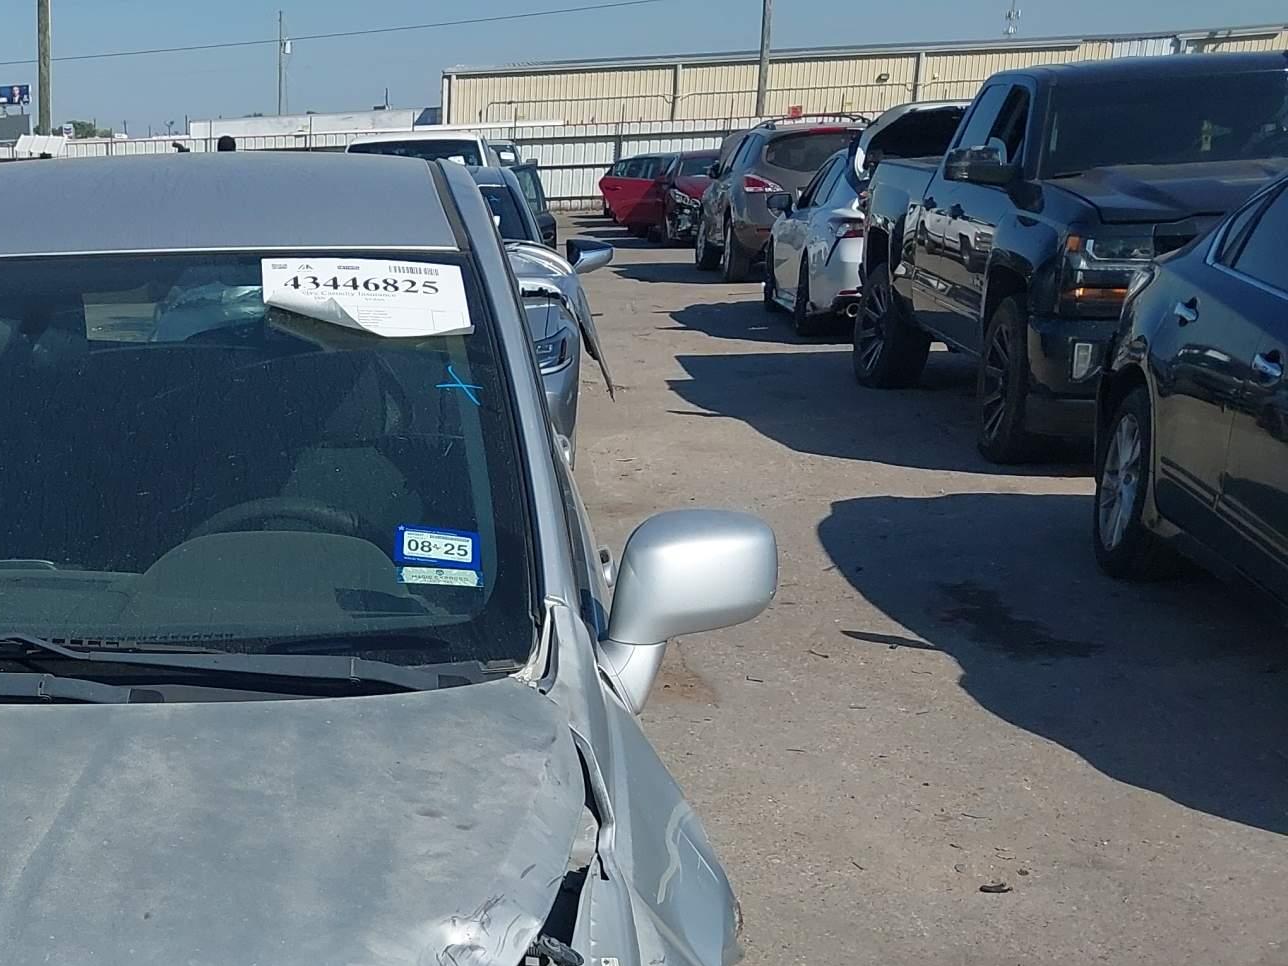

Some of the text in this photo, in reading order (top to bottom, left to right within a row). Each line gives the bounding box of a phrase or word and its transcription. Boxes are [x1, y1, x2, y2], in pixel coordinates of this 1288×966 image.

[284, 275, 439, 295] 43446825
[407, 539, 432, 553] 08
[443, 543, 469, 557] 25
